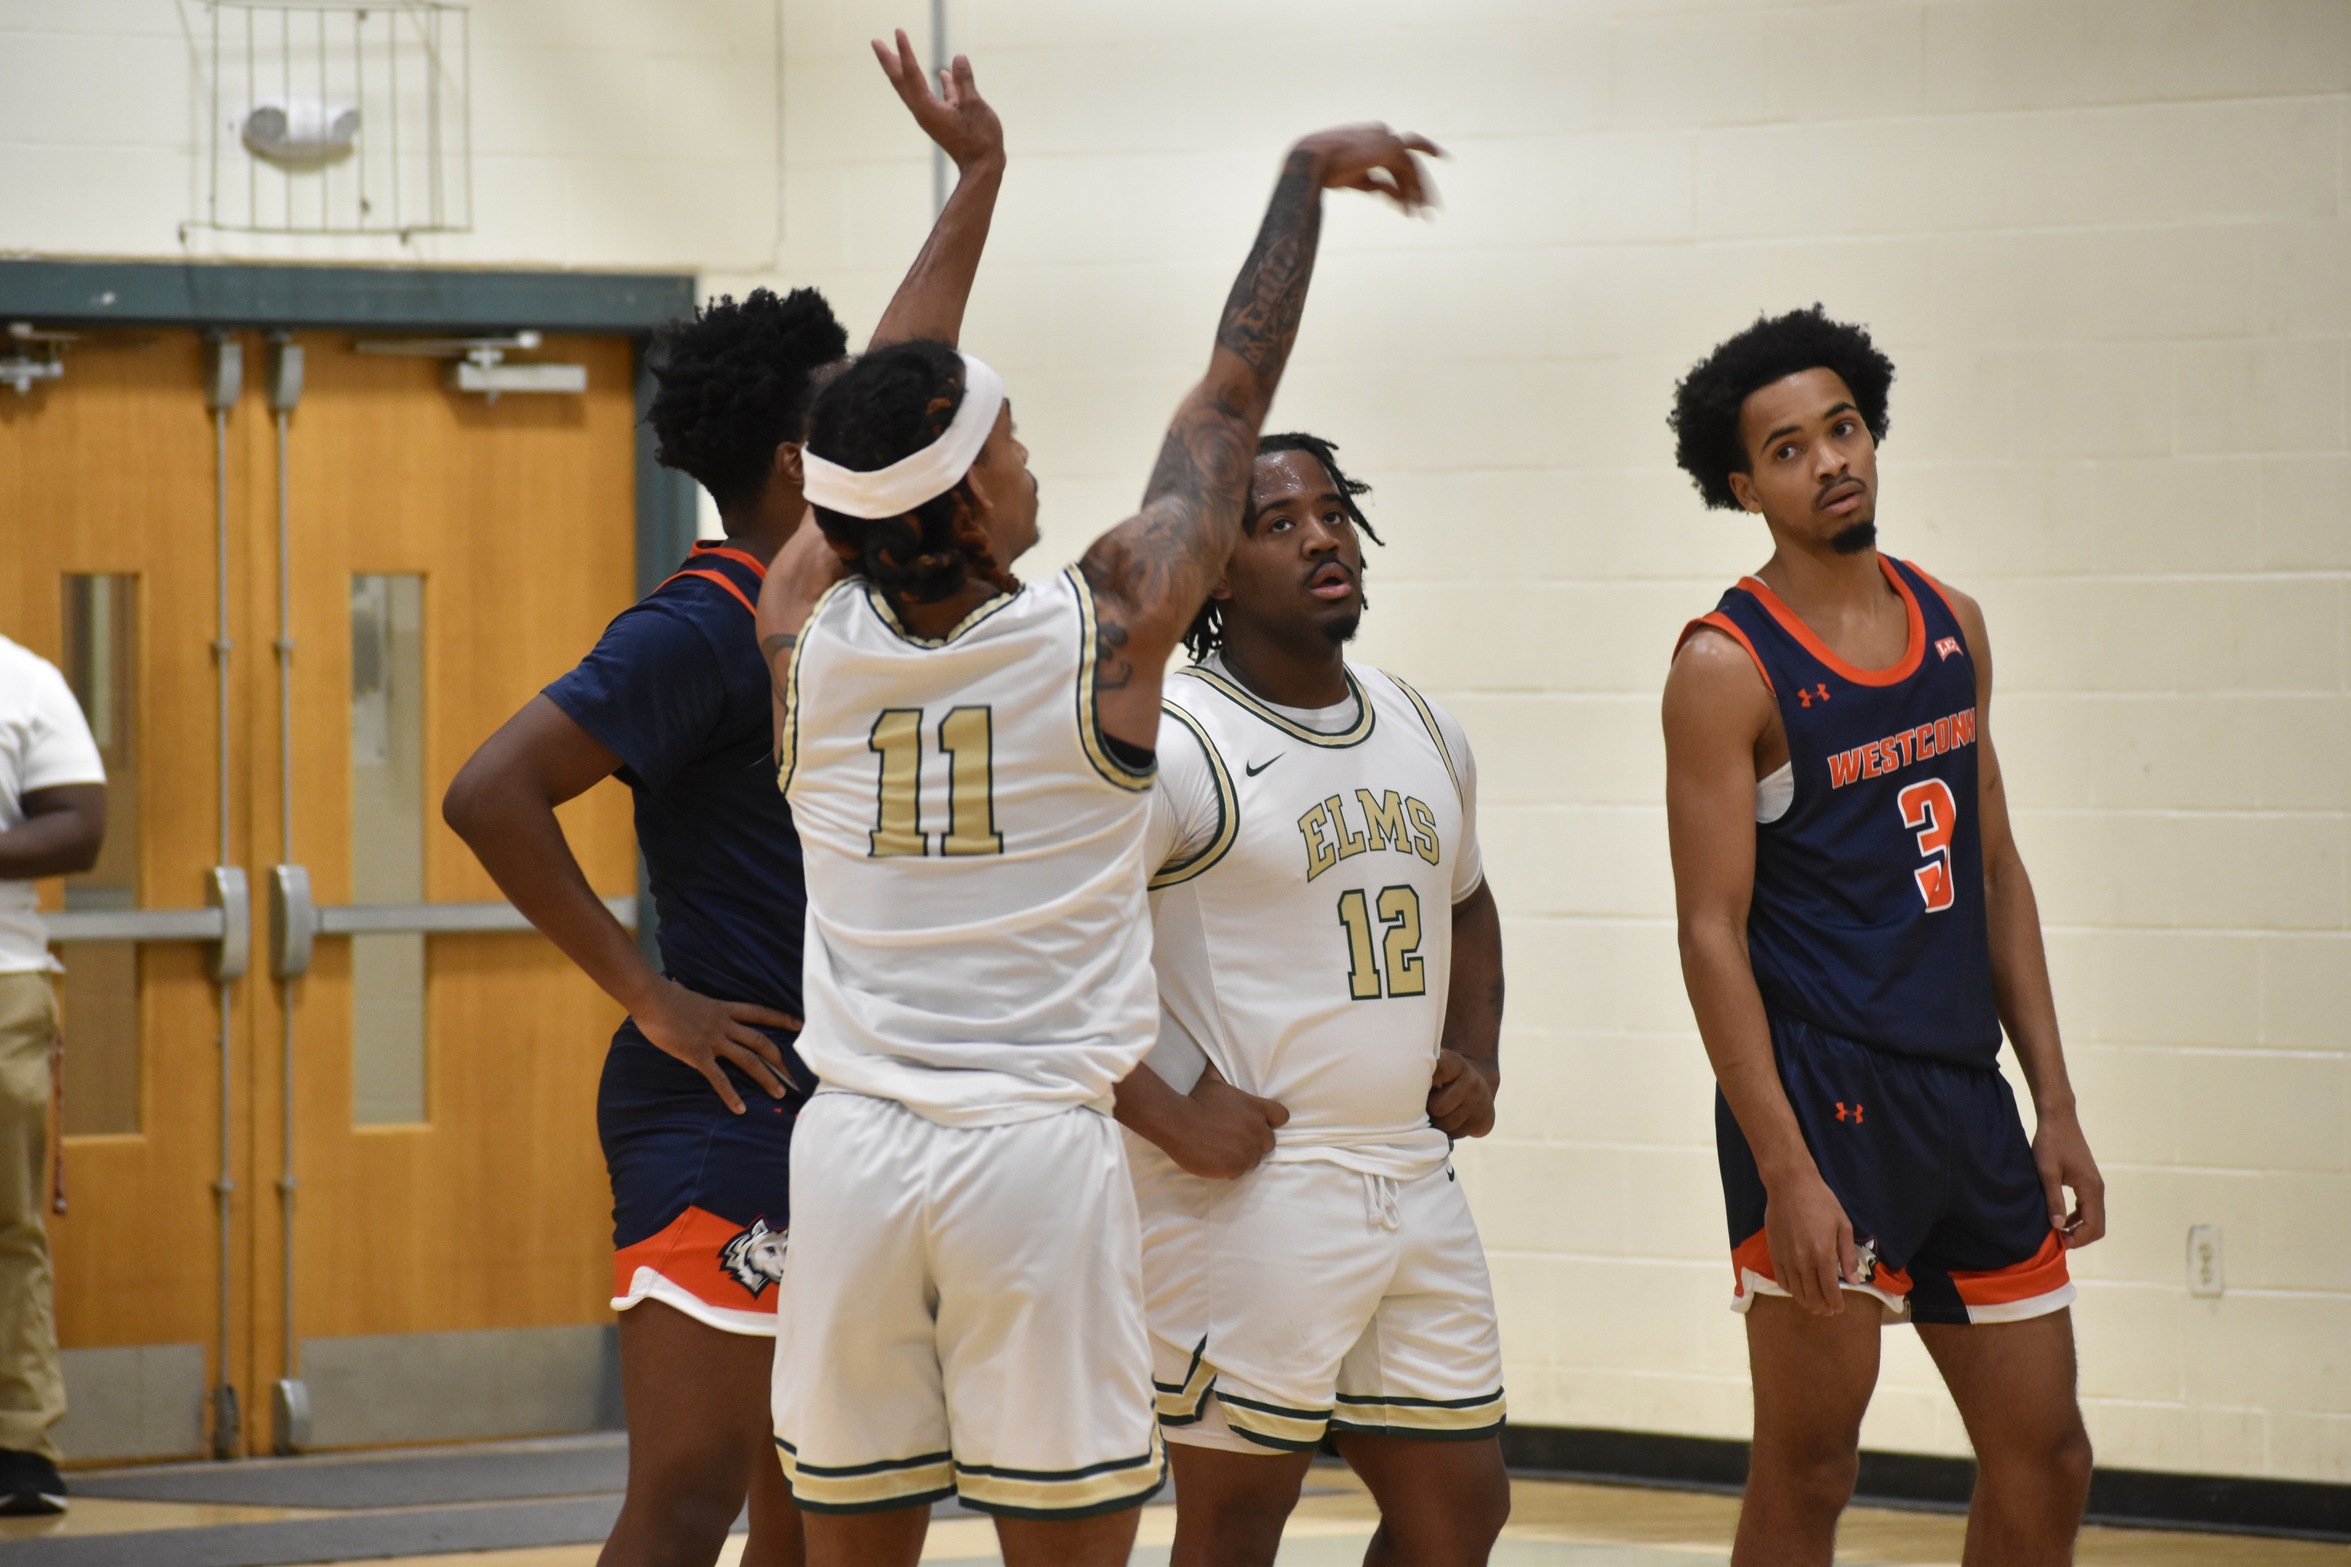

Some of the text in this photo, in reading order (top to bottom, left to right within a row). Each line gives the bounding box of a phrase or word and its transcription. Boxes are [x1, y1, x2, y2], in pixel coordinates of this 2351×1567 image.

[867, 704, 1004, 857] 11
[1827, 707, 1976, 789] WESTCONN
[1297, 788, 1440, 883] ELMS
[1897, 777, 1957, 913] 3
[1337, 884, 1426, 1001] 12
